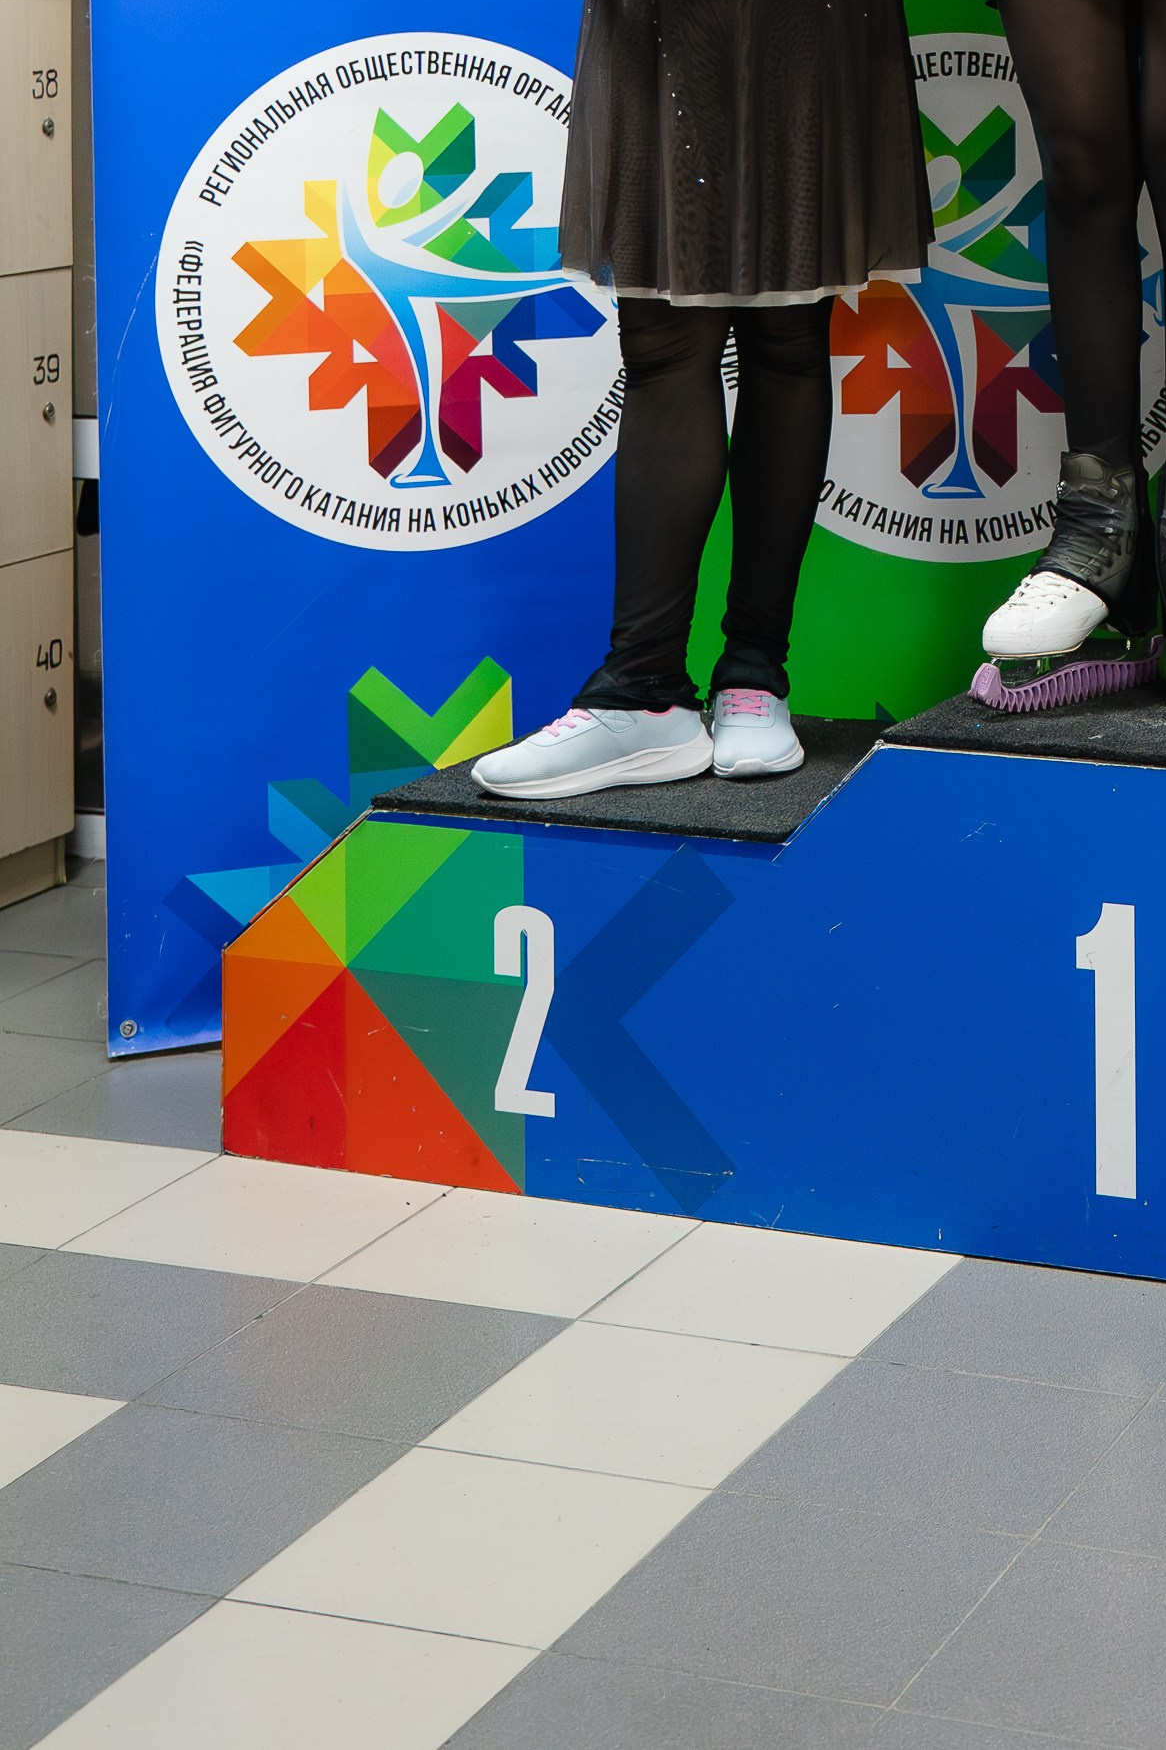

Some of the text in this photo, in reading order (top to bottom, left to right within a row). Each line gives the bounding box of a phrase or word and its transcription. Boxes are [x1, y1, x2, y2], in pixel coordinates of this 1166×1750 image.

[32, 69, 58, 99] 38
[199, 50, 572, 207] РЕГИОНАЛЬНАЯ ОБЩЕСТВЕННАЯ ОРГАН
[33, 353, 60, 385] 39
[203, 393, 304, 500] ФИГУРНОГО
[300, 485, 401, 533] КАТАНИЯ
[407, 508, 437, 533] НА
[442, 474, 543, 531] КОНЬКАХ
[831, 488, 933, 543] КАТАНИЯ
[940, 519, 969, 545] НА
[36, 639, 63, 672] 40
[493, 905, 556, 1118] 2
[1075, 902, 1137, 1199] 1
